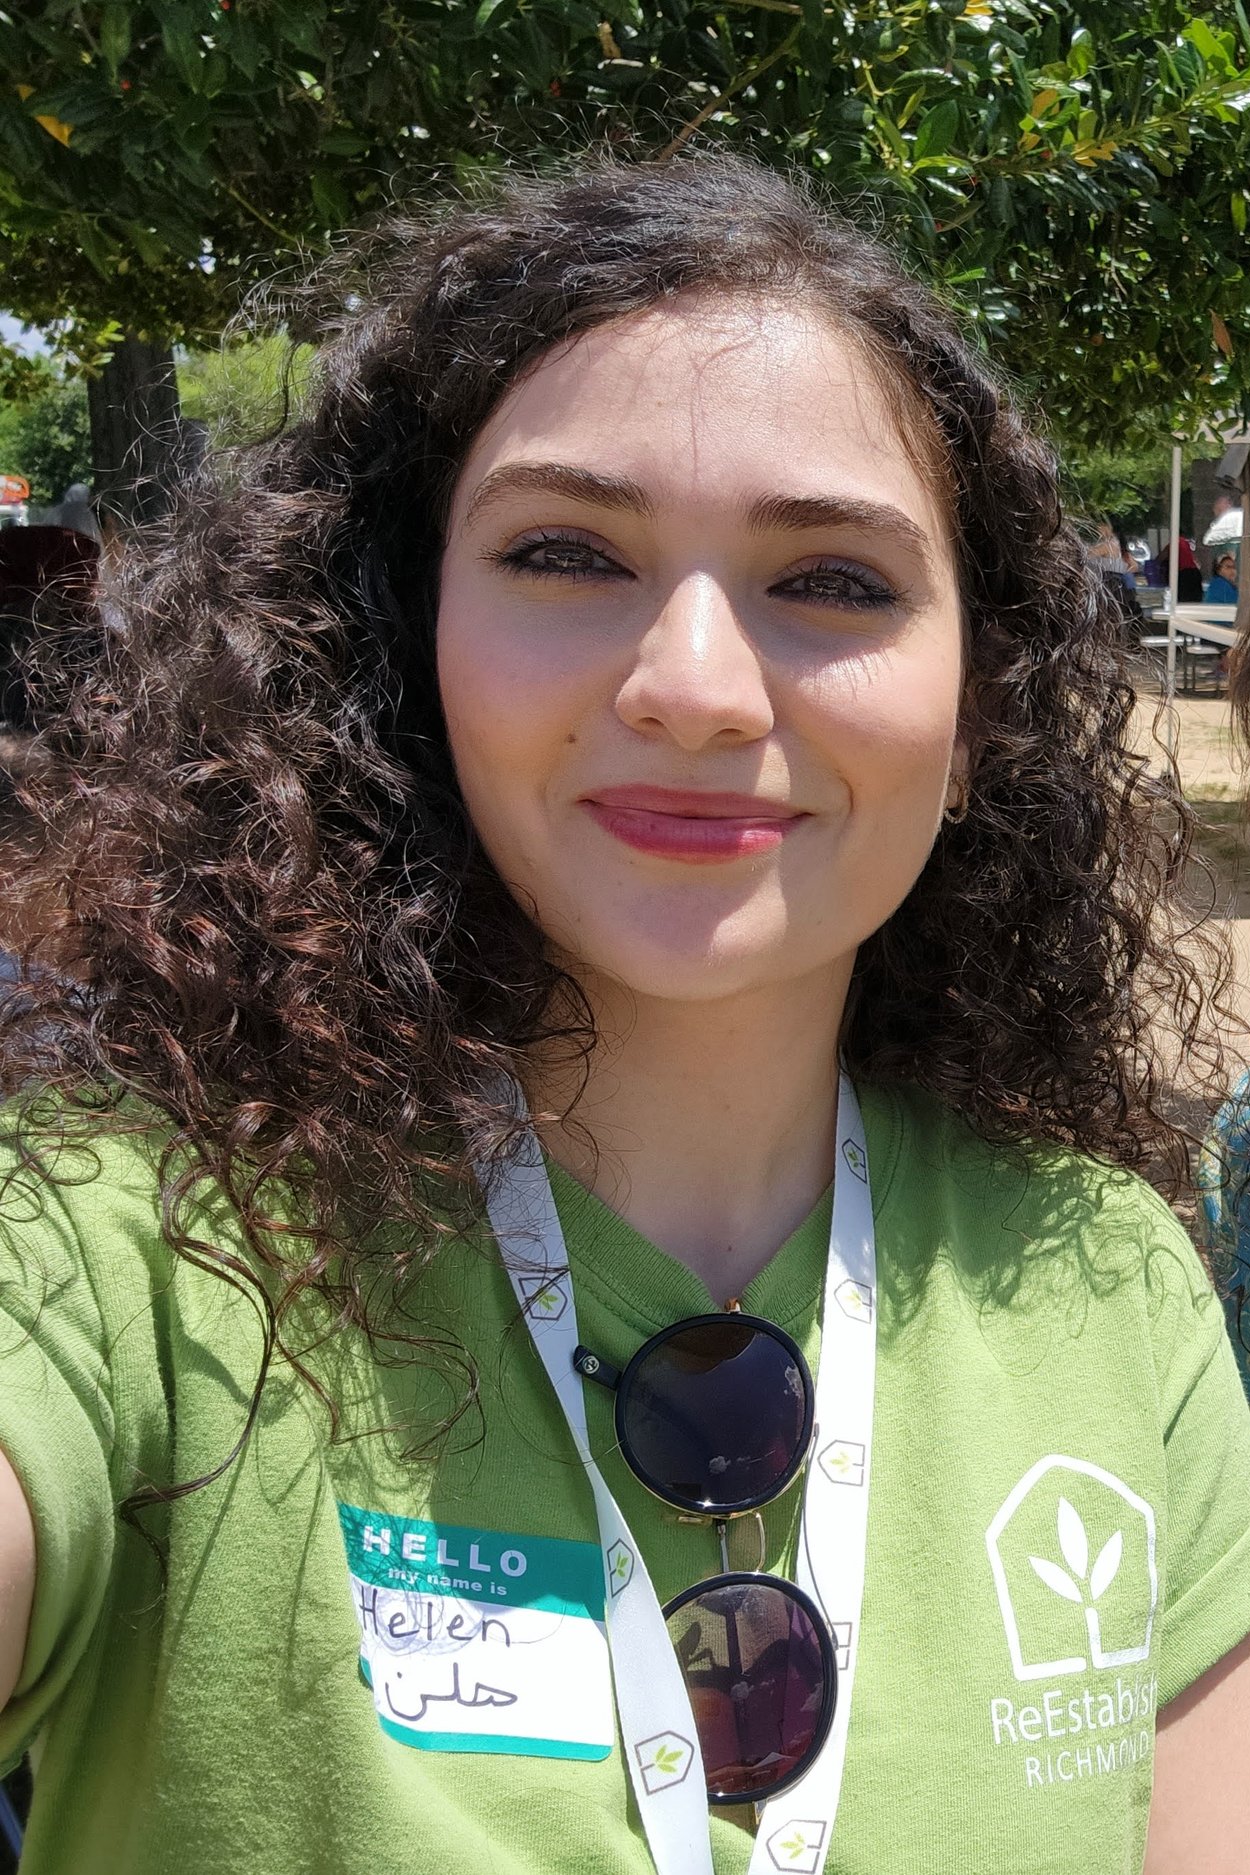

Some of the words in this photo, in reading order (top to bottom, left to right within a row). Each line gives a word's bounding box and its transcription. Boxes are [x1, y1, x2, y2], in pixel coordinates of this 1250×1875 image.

[363, 1525, 527, 1577] HELLO
[388, 1568, 419, 1585] my
[426, 1573, 483, 1593] name
[490, 1582, 508, 1596] is
[359, 1585, 511, 1648] Helen
[1025, 1730, 1150, 1788] RICHMOND
